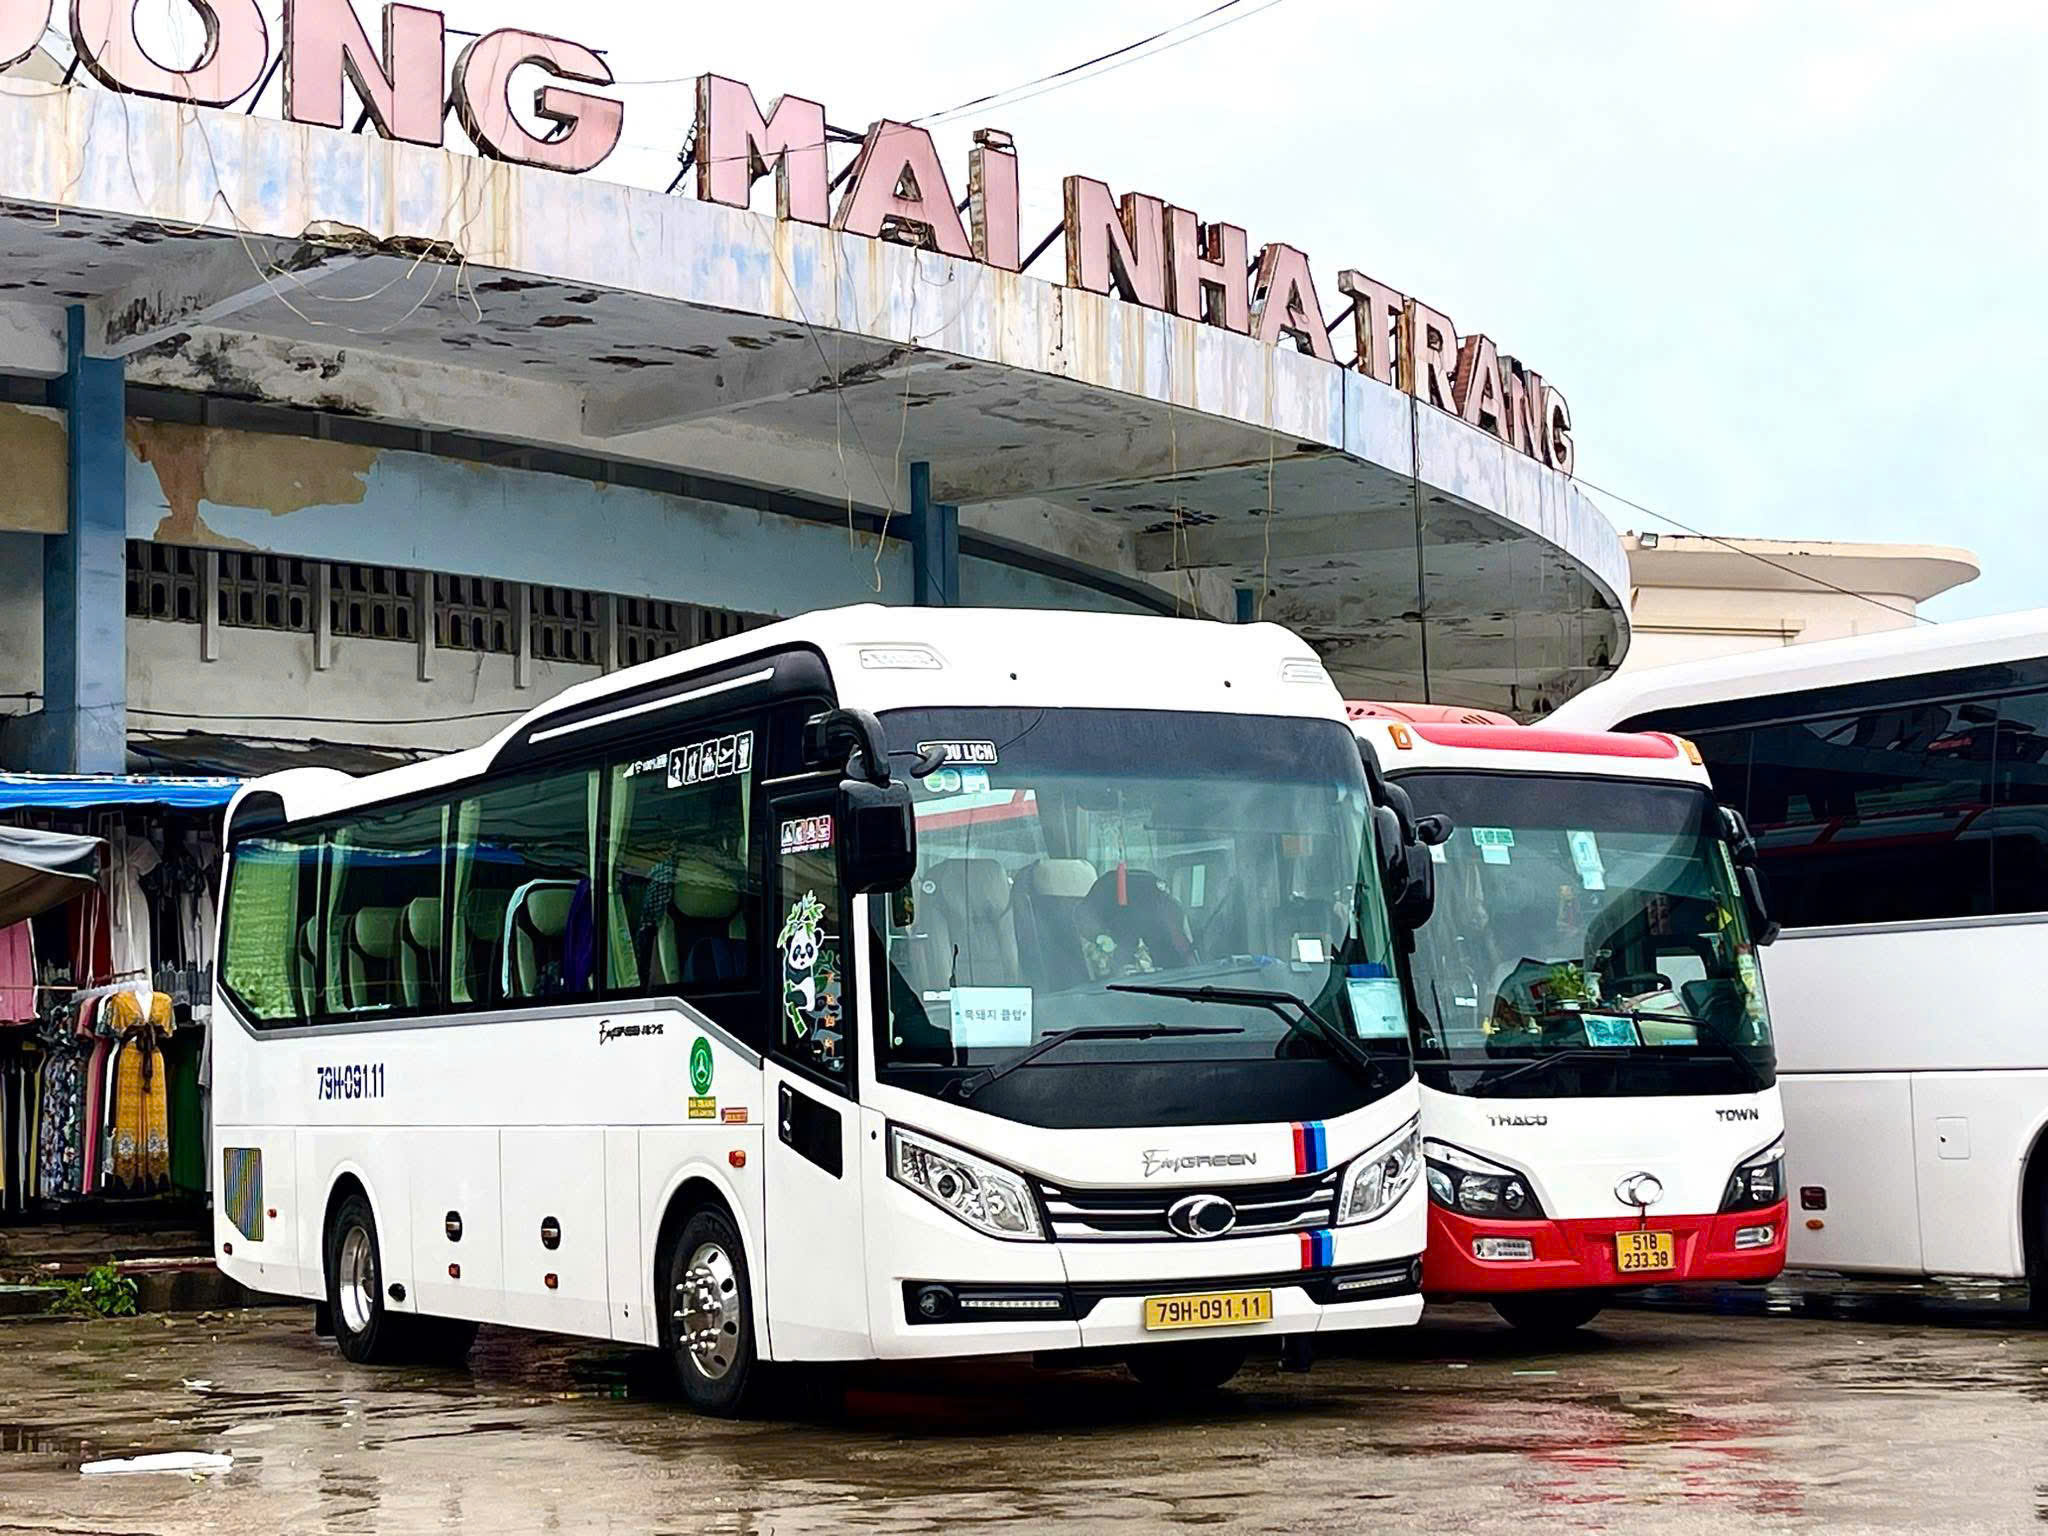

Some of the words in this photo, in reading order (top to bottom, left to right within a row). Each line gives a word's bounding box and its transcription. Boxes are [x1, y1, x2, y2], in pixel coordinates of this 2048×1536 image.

[1063, 175, 1336, 363] NHA
[1338, 269, 1574, 478] TRANG
[317, 1063, 384, 1100] 79H-091.11
[1486, 1113, 1548, 1126] THACO
[1716, 1108, 1759, 1121] TOWN
[1624, 1250, 1668, 1269] 233.38
[1156, 1296, 1260, 1323] 79H-091.11
